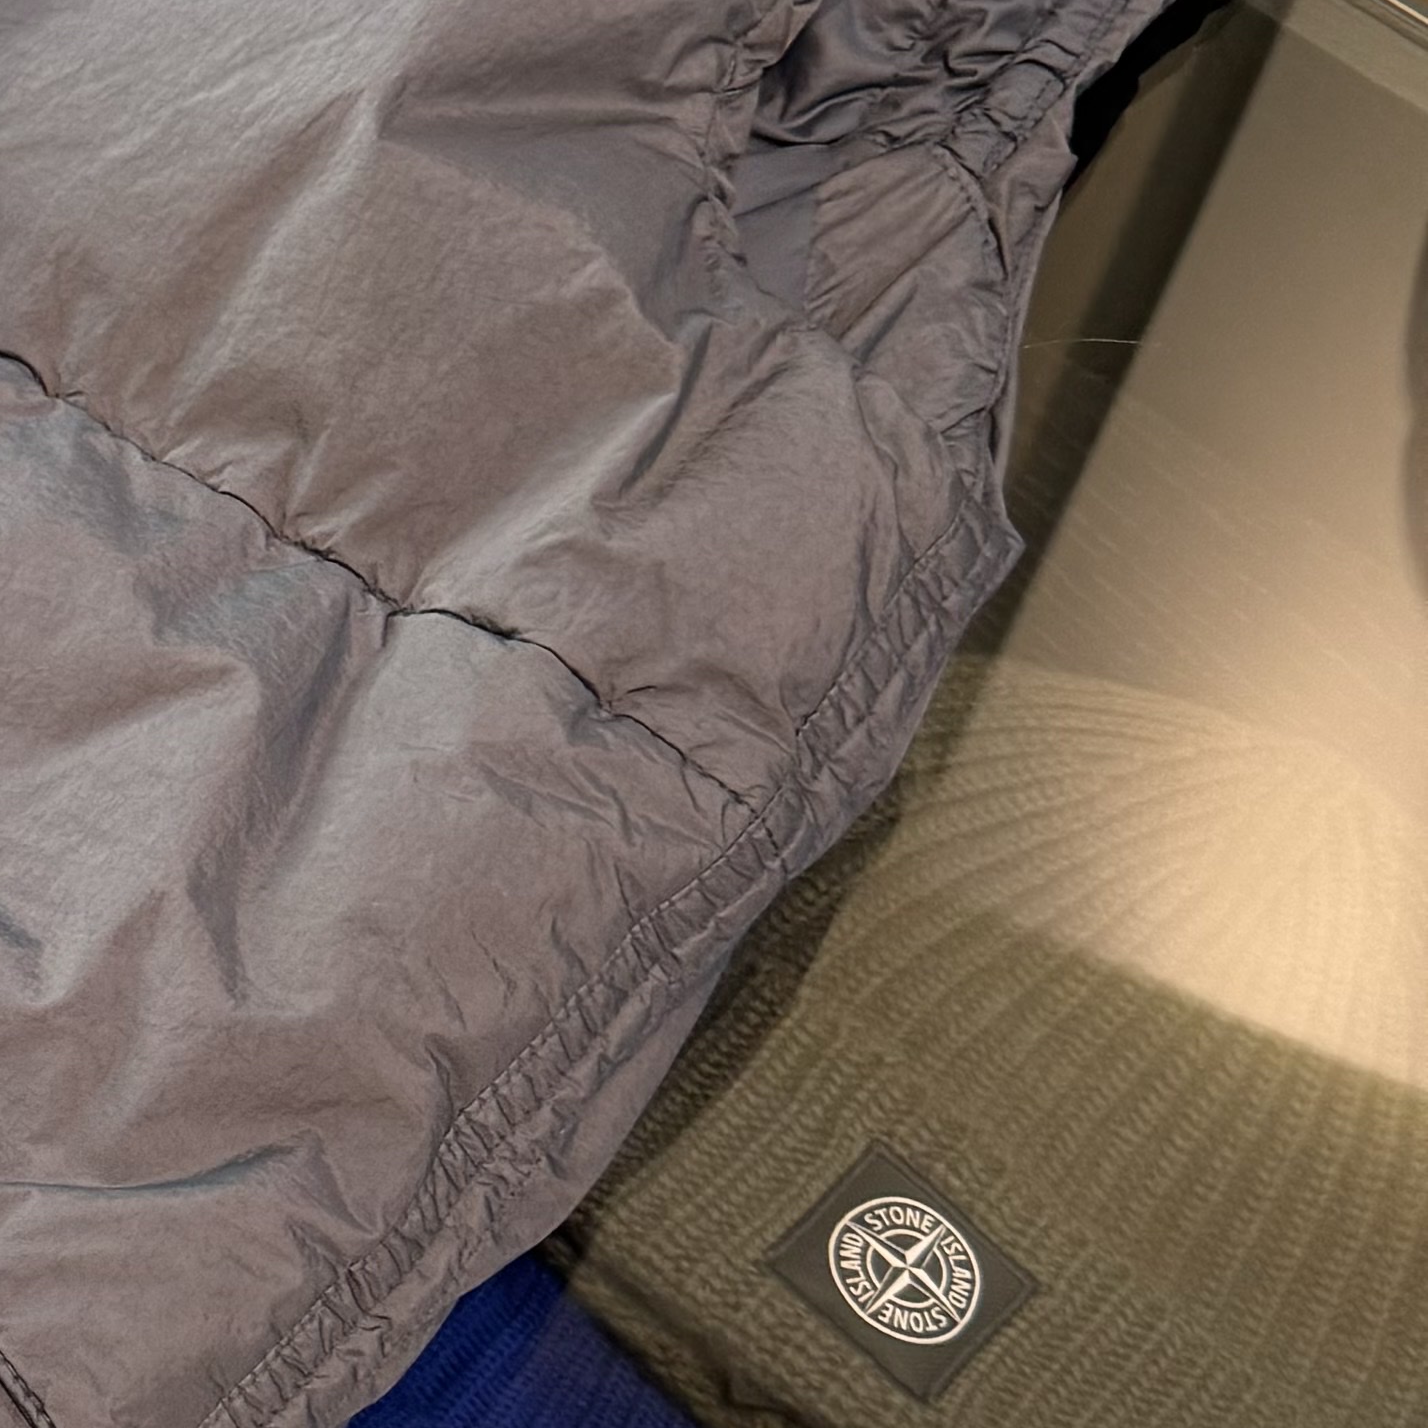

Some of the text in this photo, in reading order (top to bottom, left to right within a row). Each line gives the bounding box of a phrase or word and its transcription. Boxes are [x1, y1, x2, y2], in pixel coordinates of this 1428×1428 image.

[839, 1232, 948, 1332] STONE ISLAND
[864, 1206, 972, 1310] STONE ISLAND
